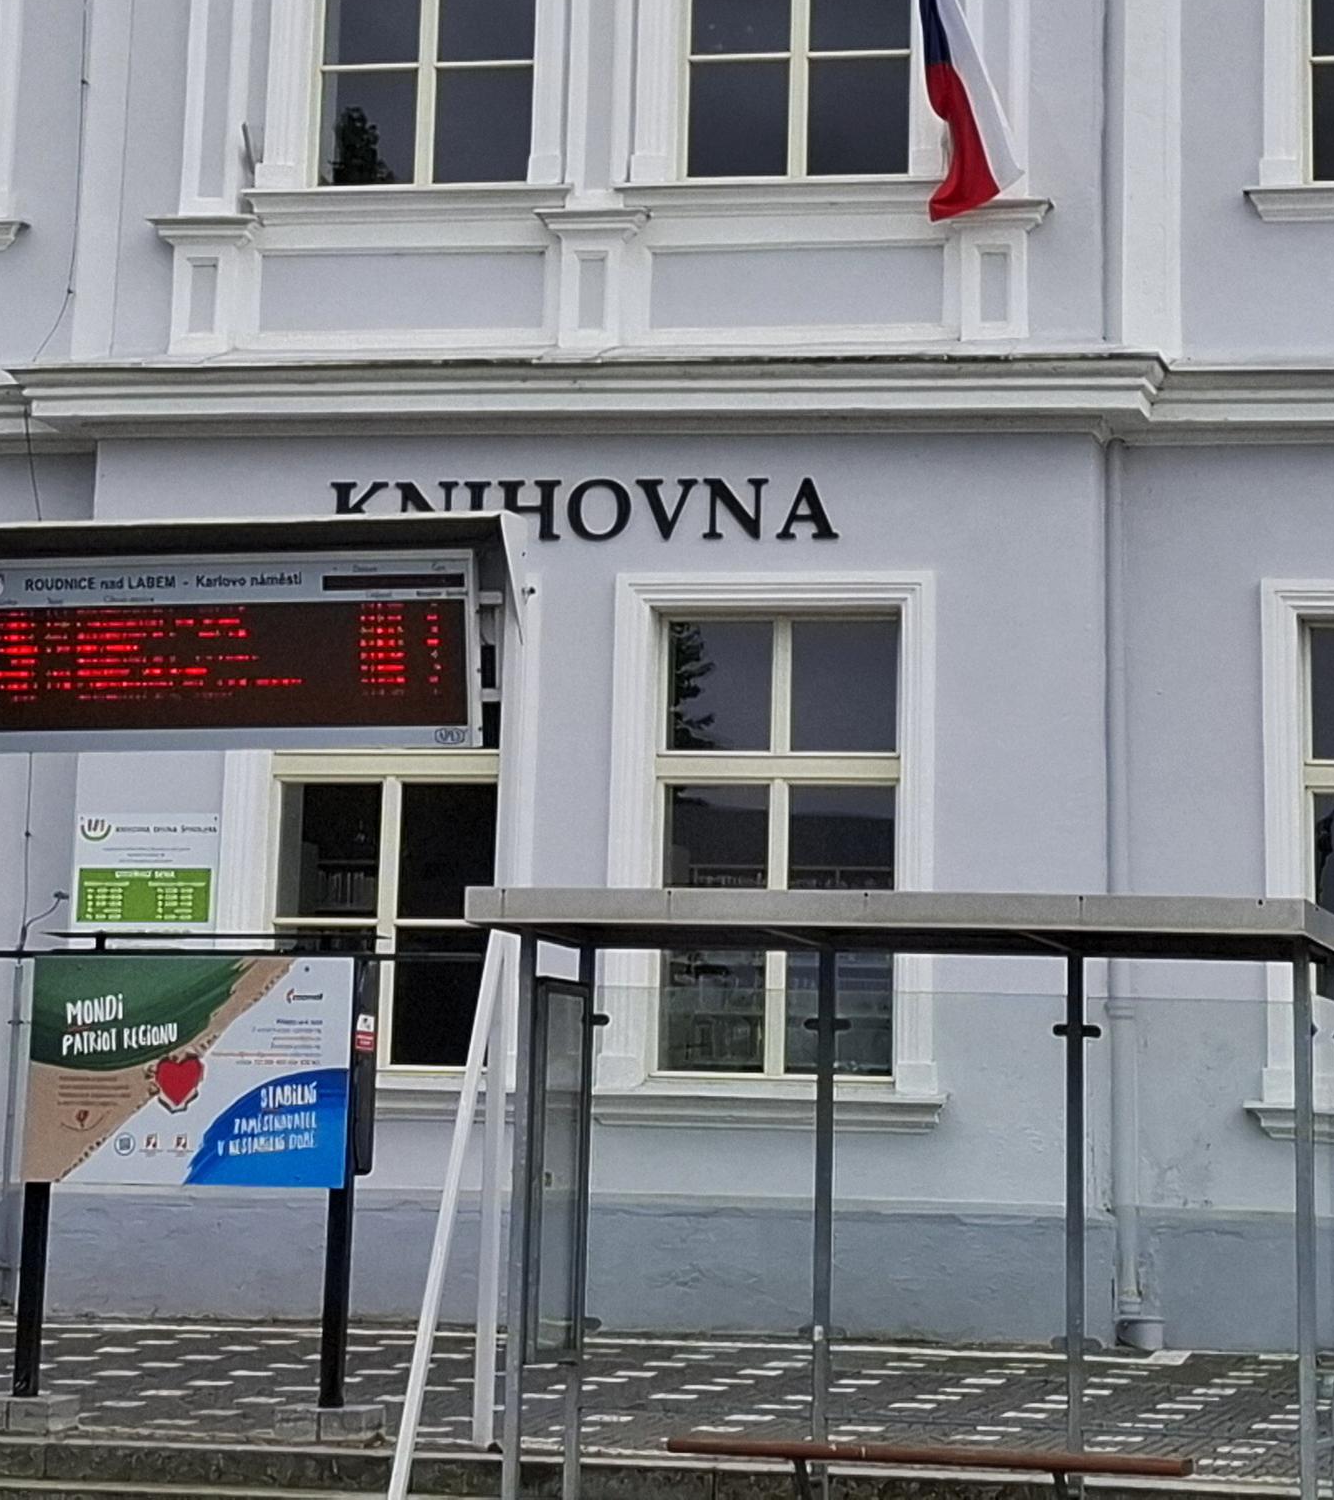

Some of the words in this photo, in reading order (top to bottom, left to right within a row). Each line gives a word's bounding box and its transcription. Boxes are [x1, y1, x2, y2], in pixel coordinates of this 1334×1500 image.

[25, 577, 95, 591] ROUDNICE
[100, 576, 124, 589] nad
[128, 575, 175, 589] LABEM
[196, 575, 246, 588] Karlovo
[250, 571, 302, 586] náměstí
